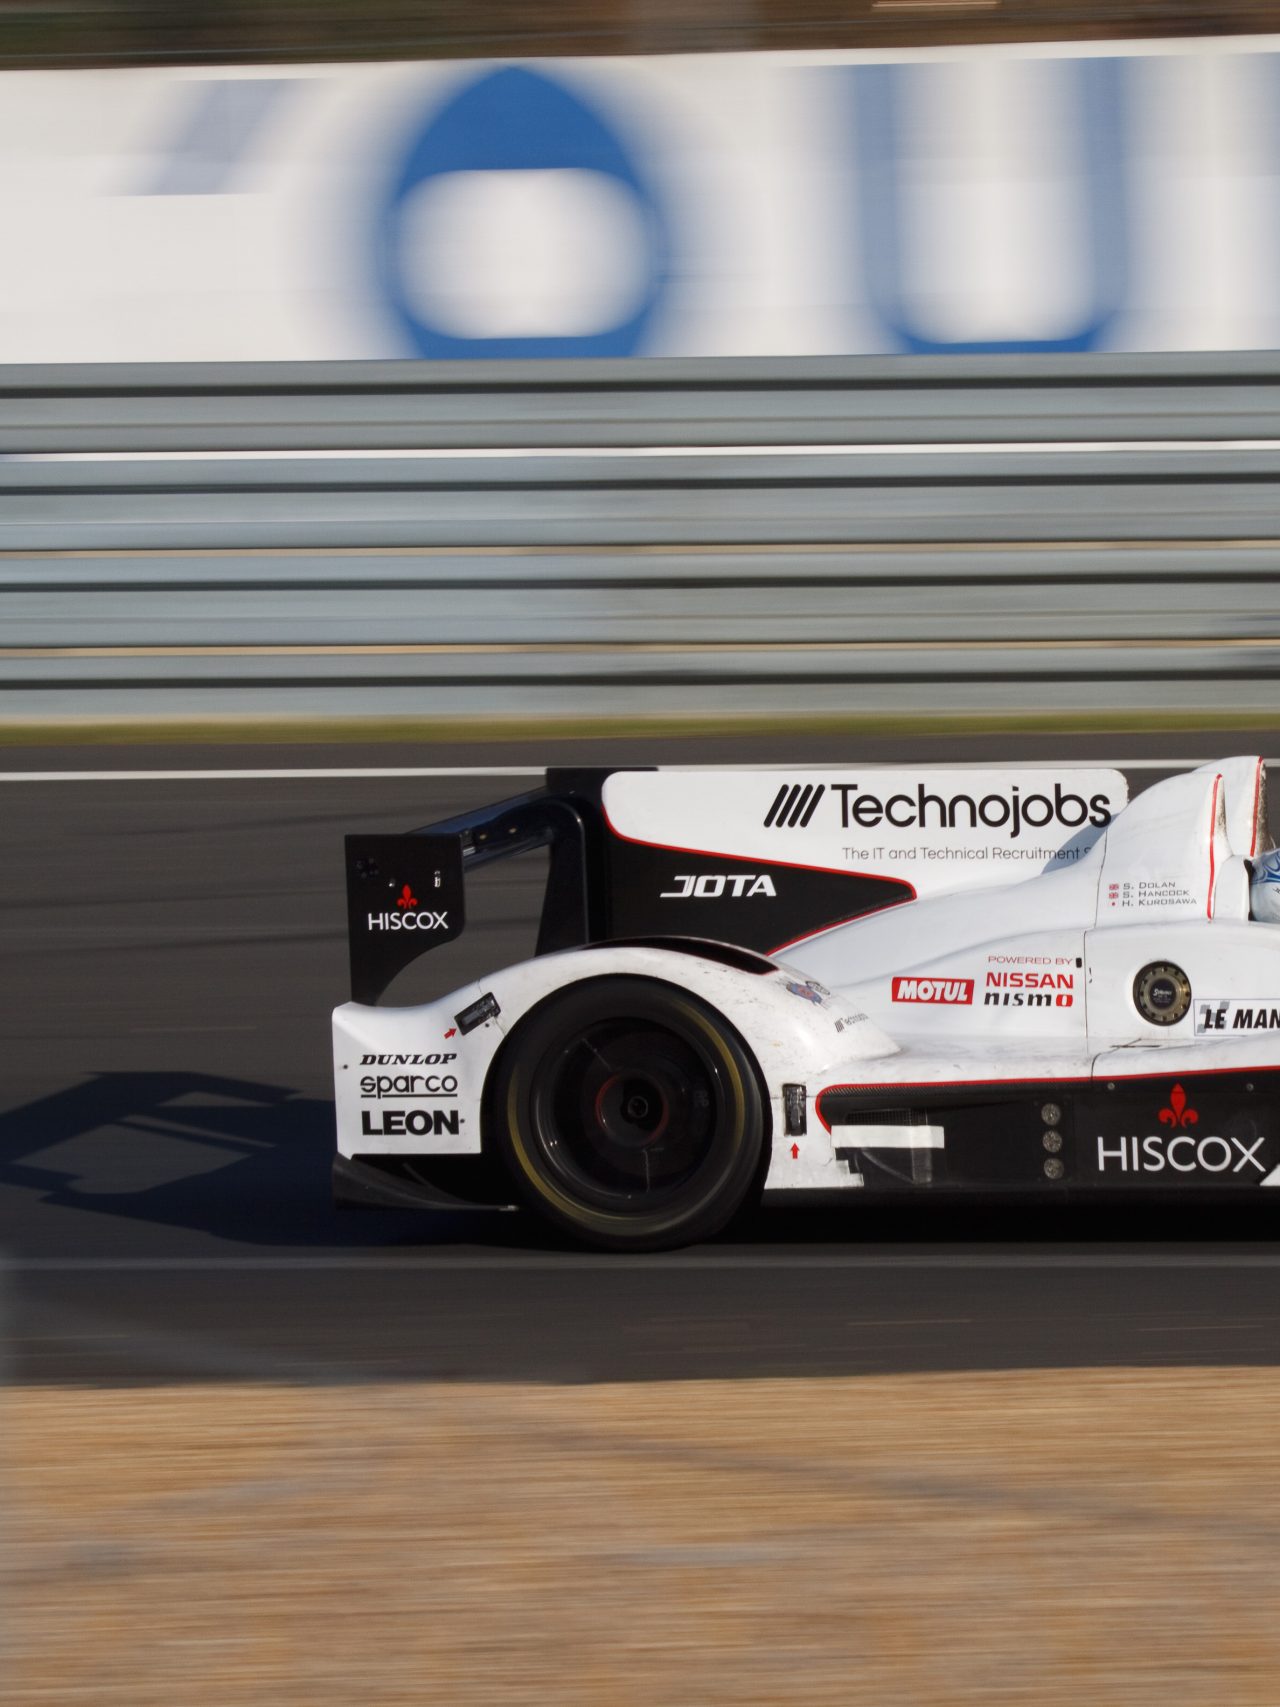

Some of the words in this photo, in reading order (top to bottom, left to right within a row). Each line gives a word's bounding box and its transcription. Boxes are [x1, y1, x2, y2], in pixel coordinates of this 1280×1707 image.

[831, 783, 1112, 838] Technojobs
[842, 847, 869, 860] The
[872, 847, 884, 860] IT
[888, 847, 916, 860] and
[920, 846, 988, 860] Technical
[993, 846, 1080, 860] Recruitment
[660, 874, 777, 898] JOTA
[368, 911, 449, 931] HISCOX
[987, 955, 1052, 965] POWERED
[897, 978, 968, 1003] MOTUL
[985, 972, 1073, 989] NISSAN
[983, 992, 1073, 1007] nismo
[1203, 1008, 1227, 1030] LE
[359, 1053, 457, 1065] DUNLOP
[360, 1075, 458, 1099] sparco
[361, 1110, 460, 1136] LEON
[1097, 1136, 1266, 1173] HISCOX
